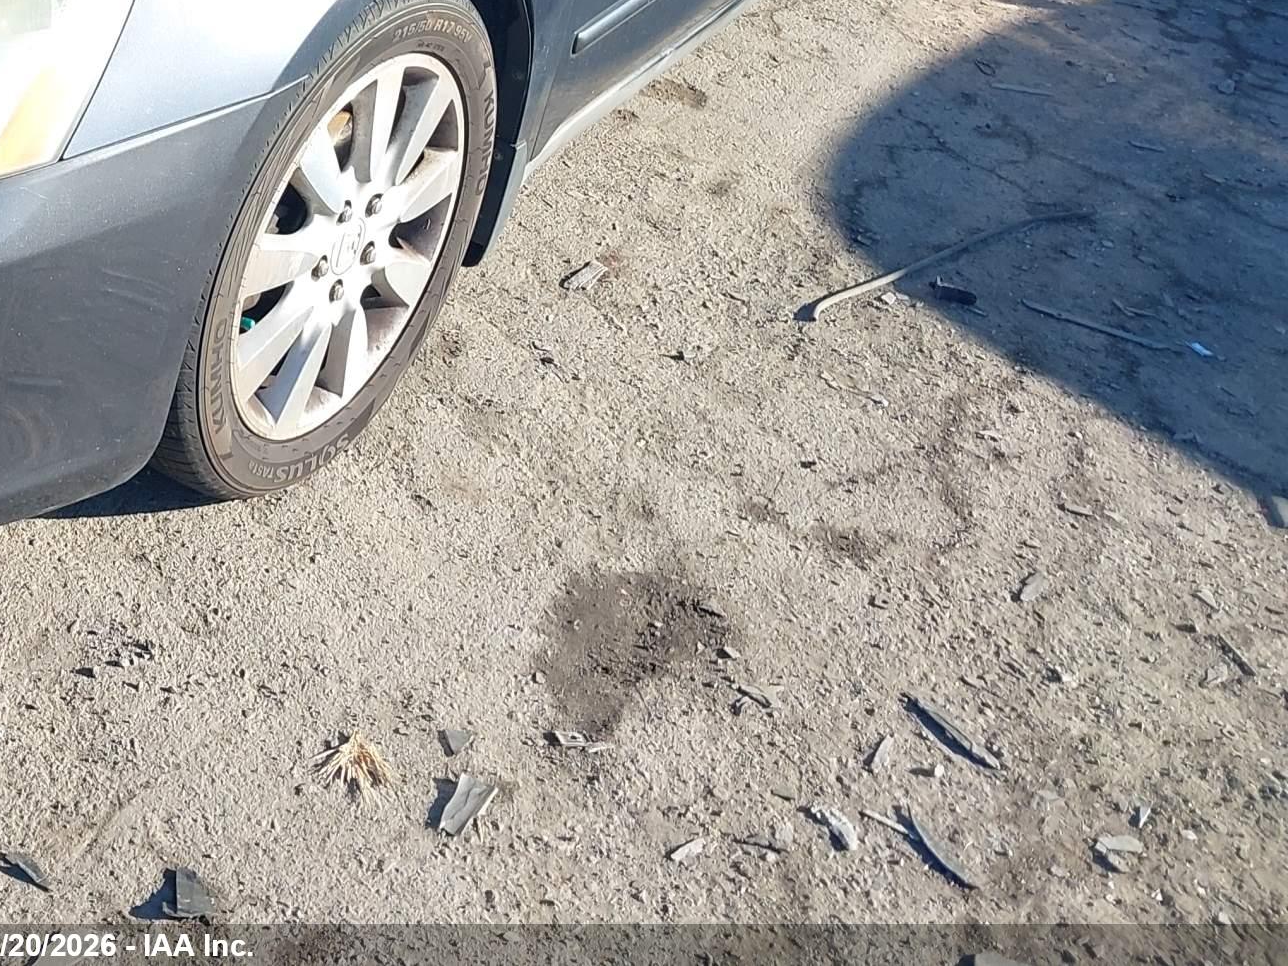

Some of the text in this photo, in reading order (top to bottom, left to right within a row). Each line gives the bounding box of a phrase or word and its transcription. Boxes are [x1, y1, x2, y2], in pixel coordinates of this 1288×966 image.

[392, 18, 432, 43] 215/50
[433, 18, 454, 34] R17
[475, 89, 495, 196] KUMHO
[210, 317, 228, 435] KUMHO
[274, 433, 351, 483] SOLUS
